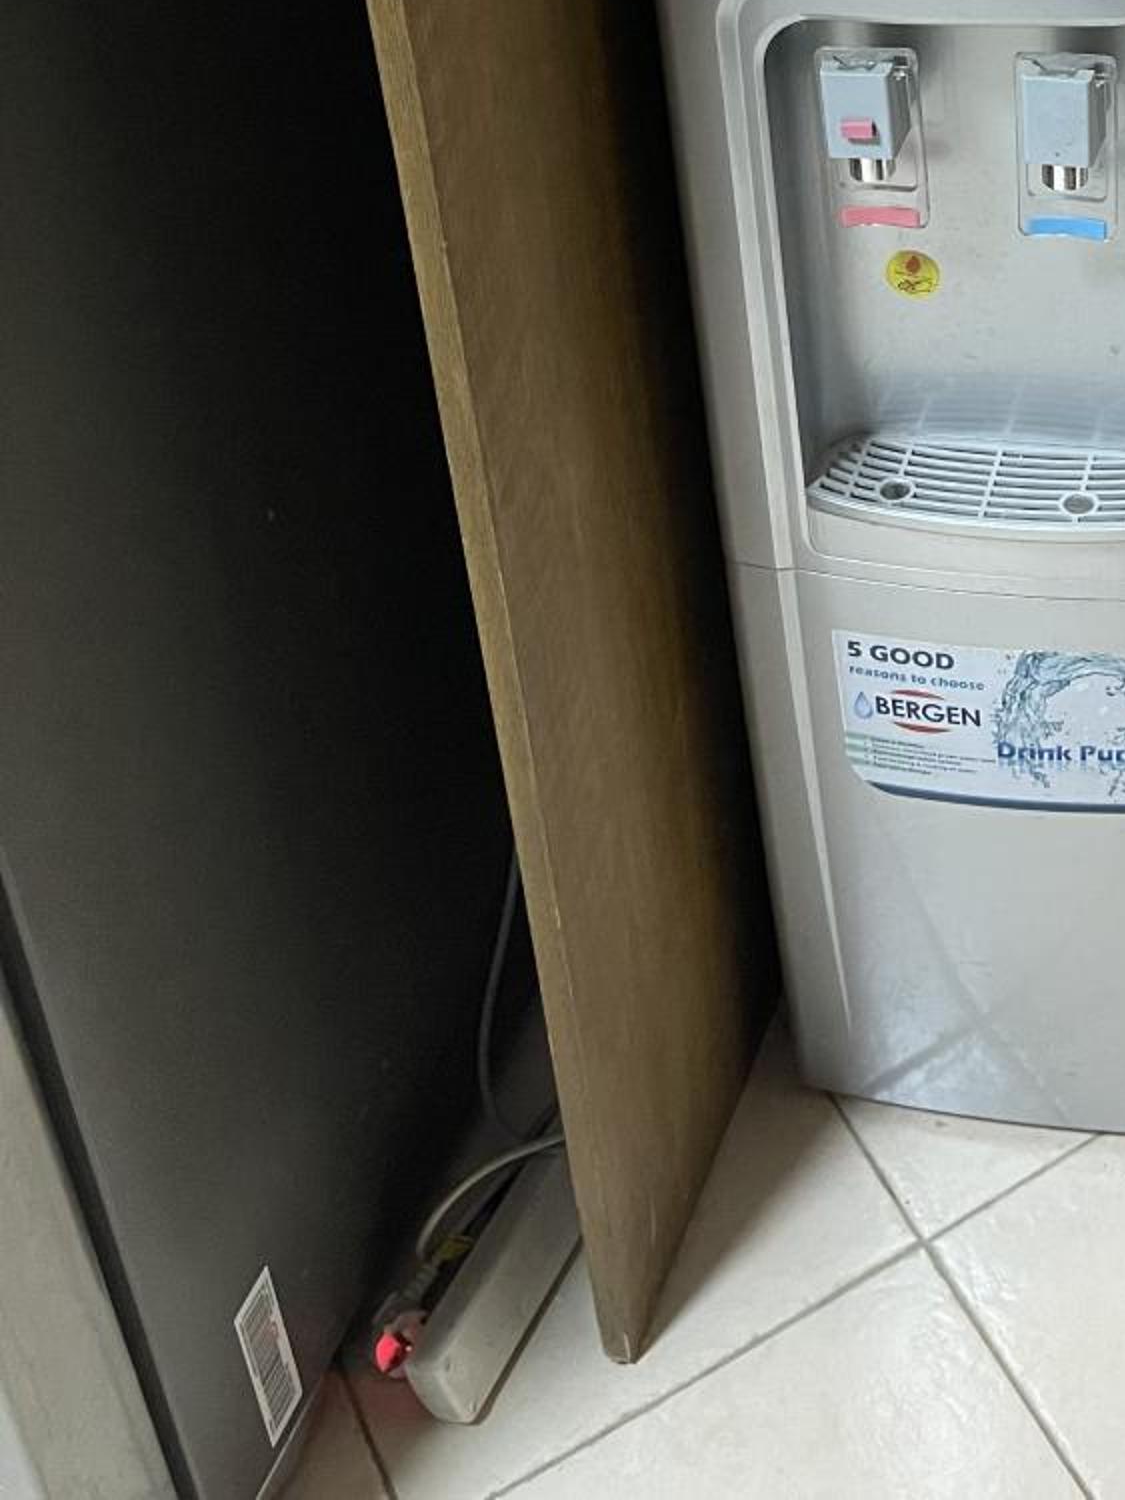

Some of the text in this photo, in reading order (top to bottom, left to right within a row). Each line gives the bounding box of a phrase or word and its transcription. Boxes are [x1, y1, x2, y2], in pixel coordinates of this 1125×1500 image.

[847, 641, 955, 670] 5 GOOD
[849, 666, 985, 692] reasons to choose
[874, 696, 982, 727] BERGEN
[997, 741, 1072, 761] Drink
